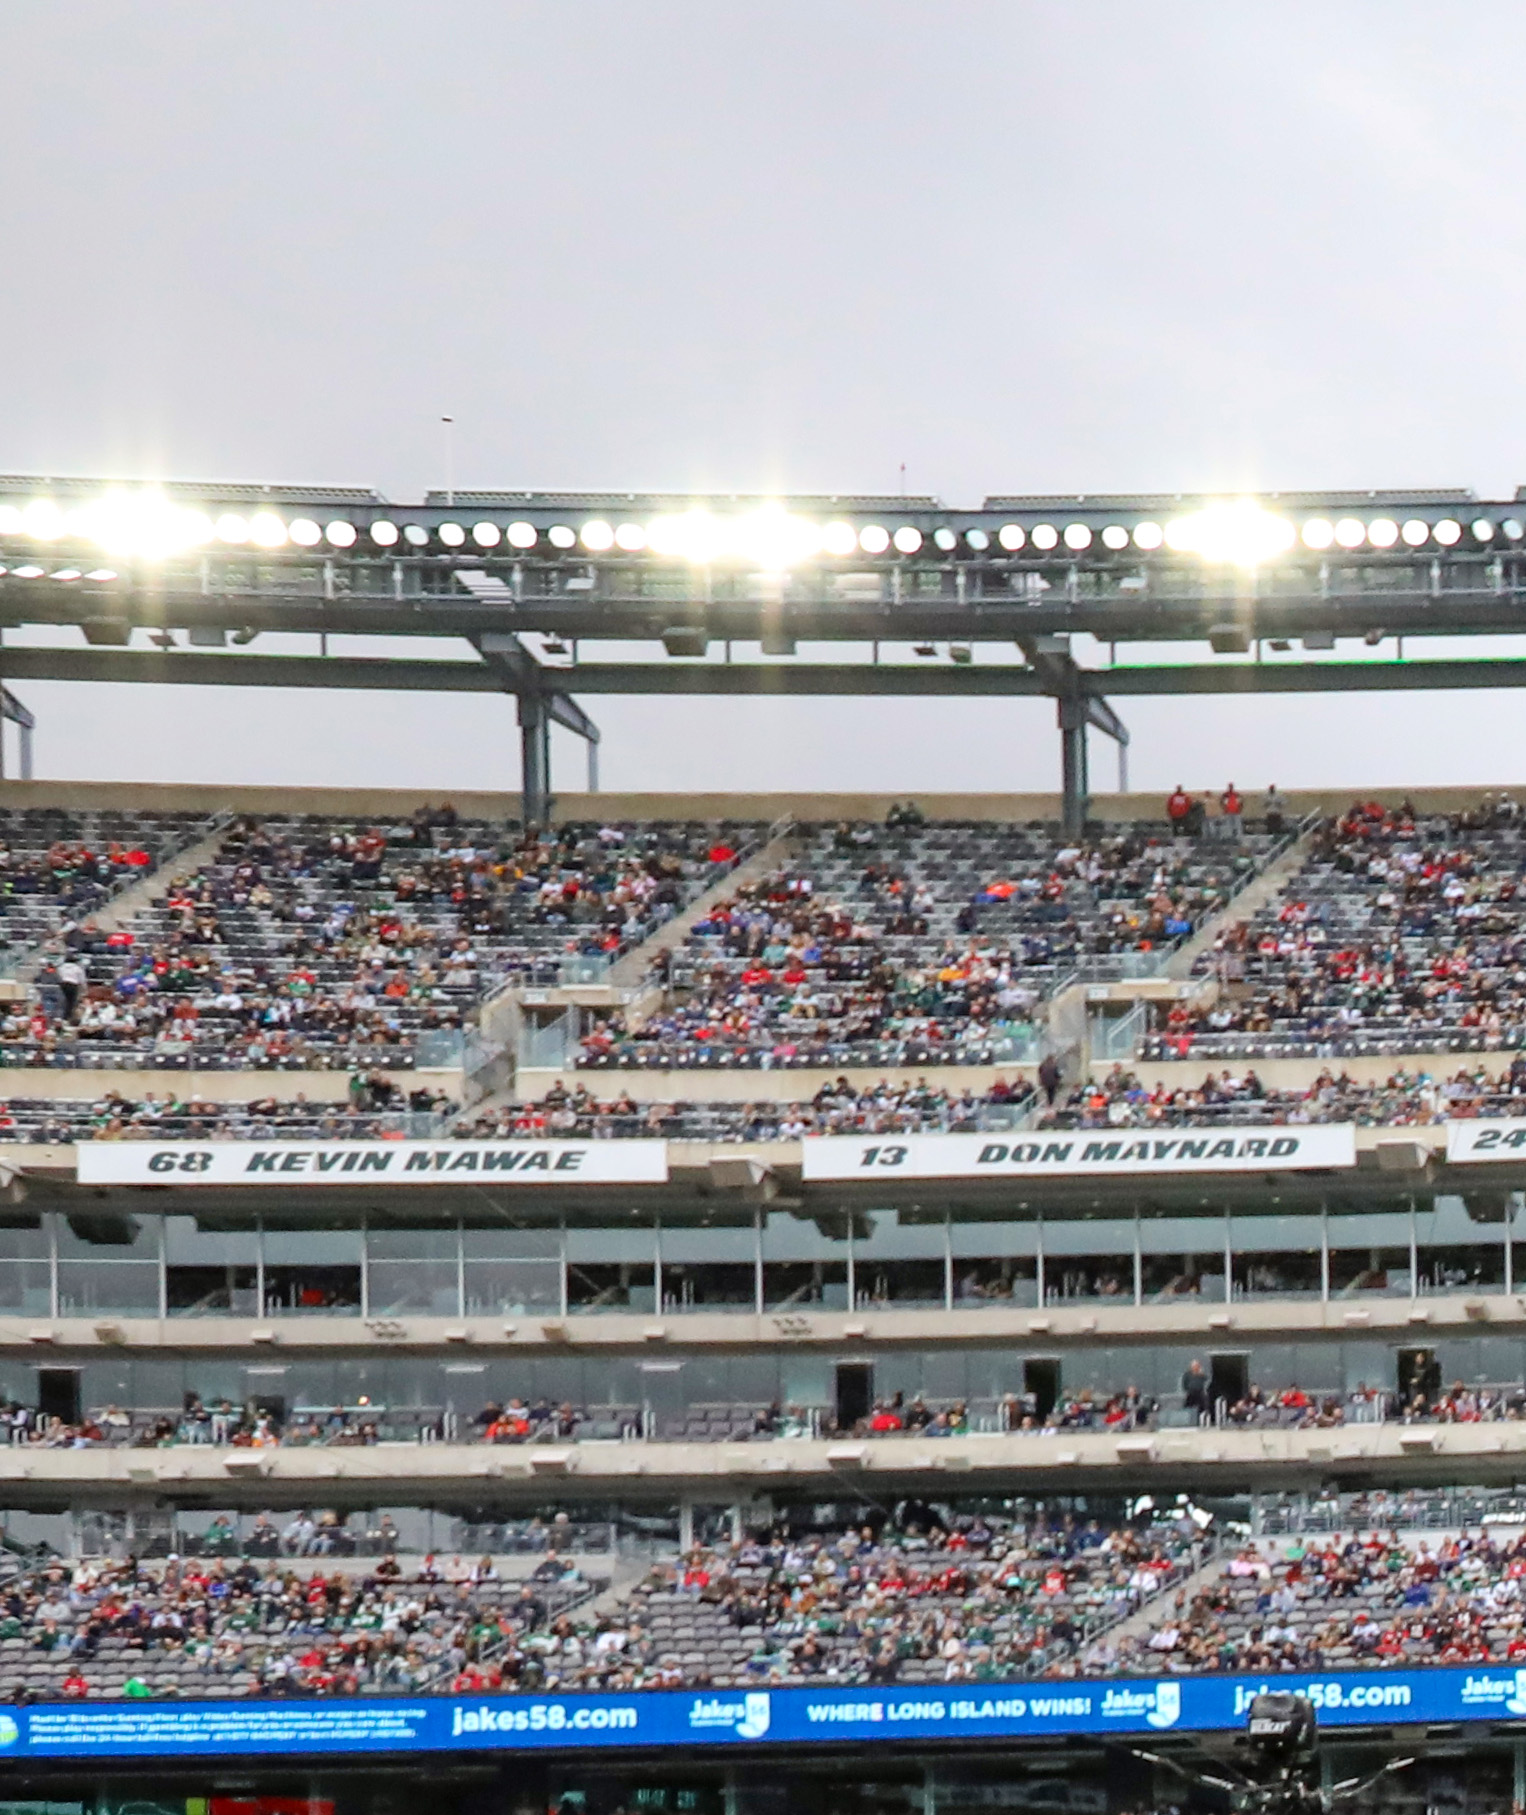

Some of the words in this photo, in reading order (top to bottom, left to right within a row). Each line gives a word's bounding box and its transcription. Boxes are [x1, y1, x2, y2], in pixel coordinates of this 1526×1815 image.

[147, 1150, 212, 1173] 68
[245, 1150, 395, 1173] KEVIN
[403, 1149, 587, 1172] MAWAE
[860, 1145, 909, 1167] 13
[976, 1142, 1075, 1165] DON
[1080, 1137, 1300, 1163] MAYNARD
[452, 1704, 638, 1738] jakes58.com
[807, 1700, 884, 1722] WHERE
[886, 1701, 947, 1721] LONG
[950, 1699, 1027, 1720] ISLAND
[1029, 1697, 1092, 1718] WINS!
